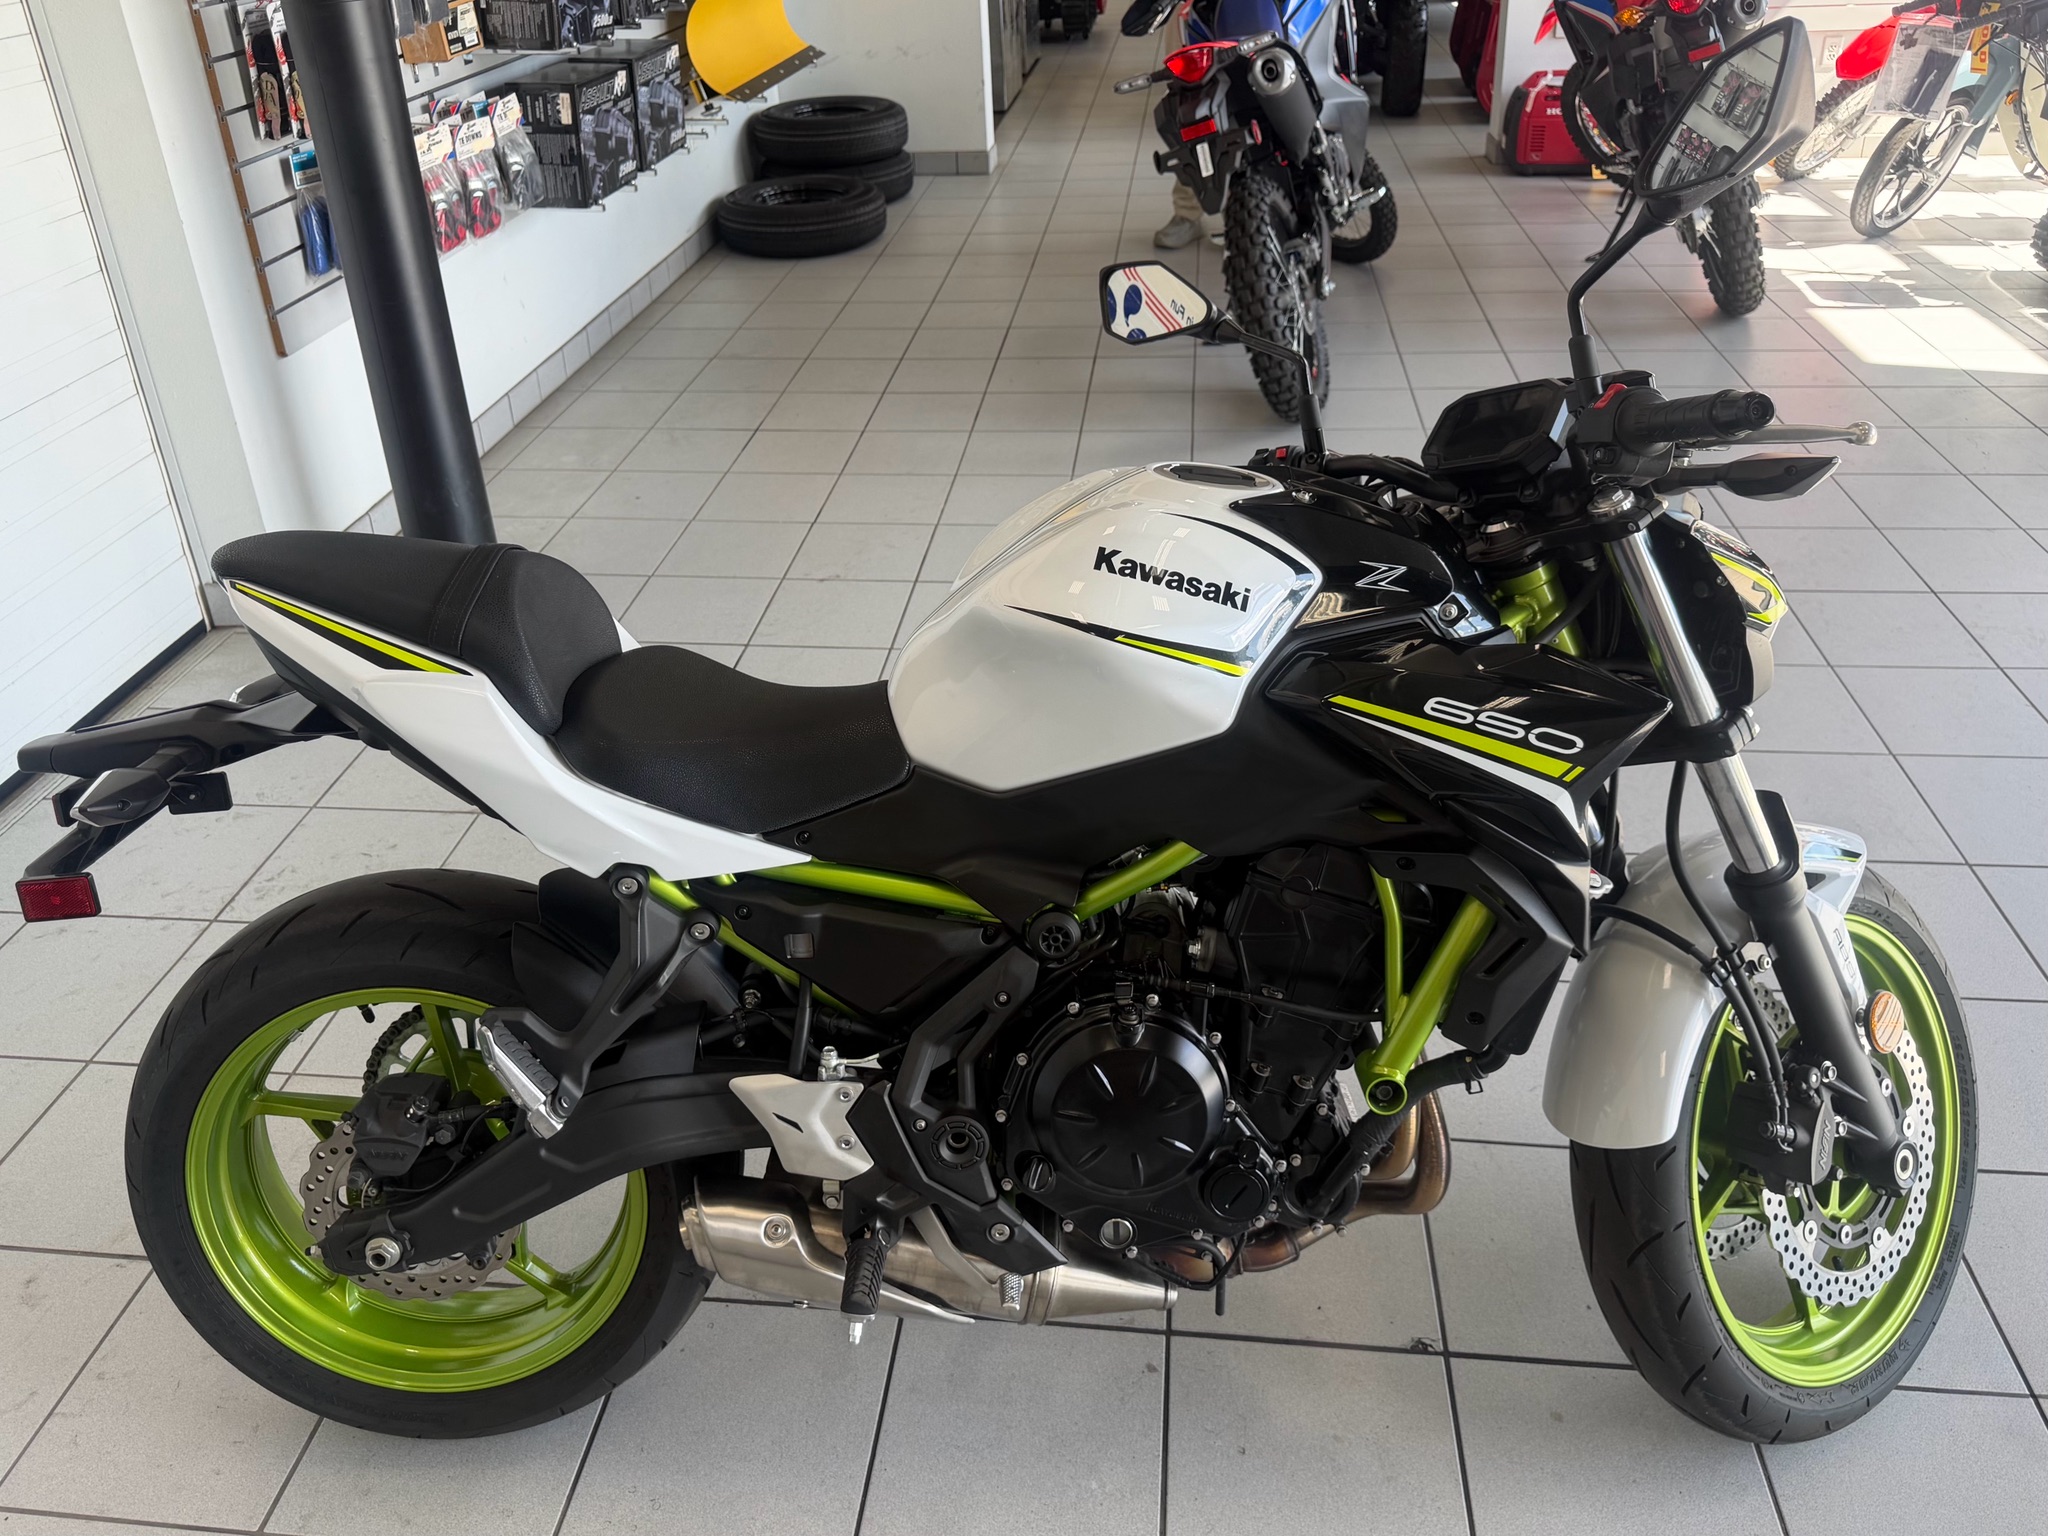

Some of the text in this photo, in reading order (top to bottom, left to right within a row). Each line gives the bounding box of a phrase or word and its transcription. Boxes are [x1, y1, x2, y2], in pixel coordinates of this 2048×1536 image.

[1093, 546, 1251, 613] Kawasaki
[1355, 560, 1410, 593] Z
[1423, 697, 1585, 755] 650
